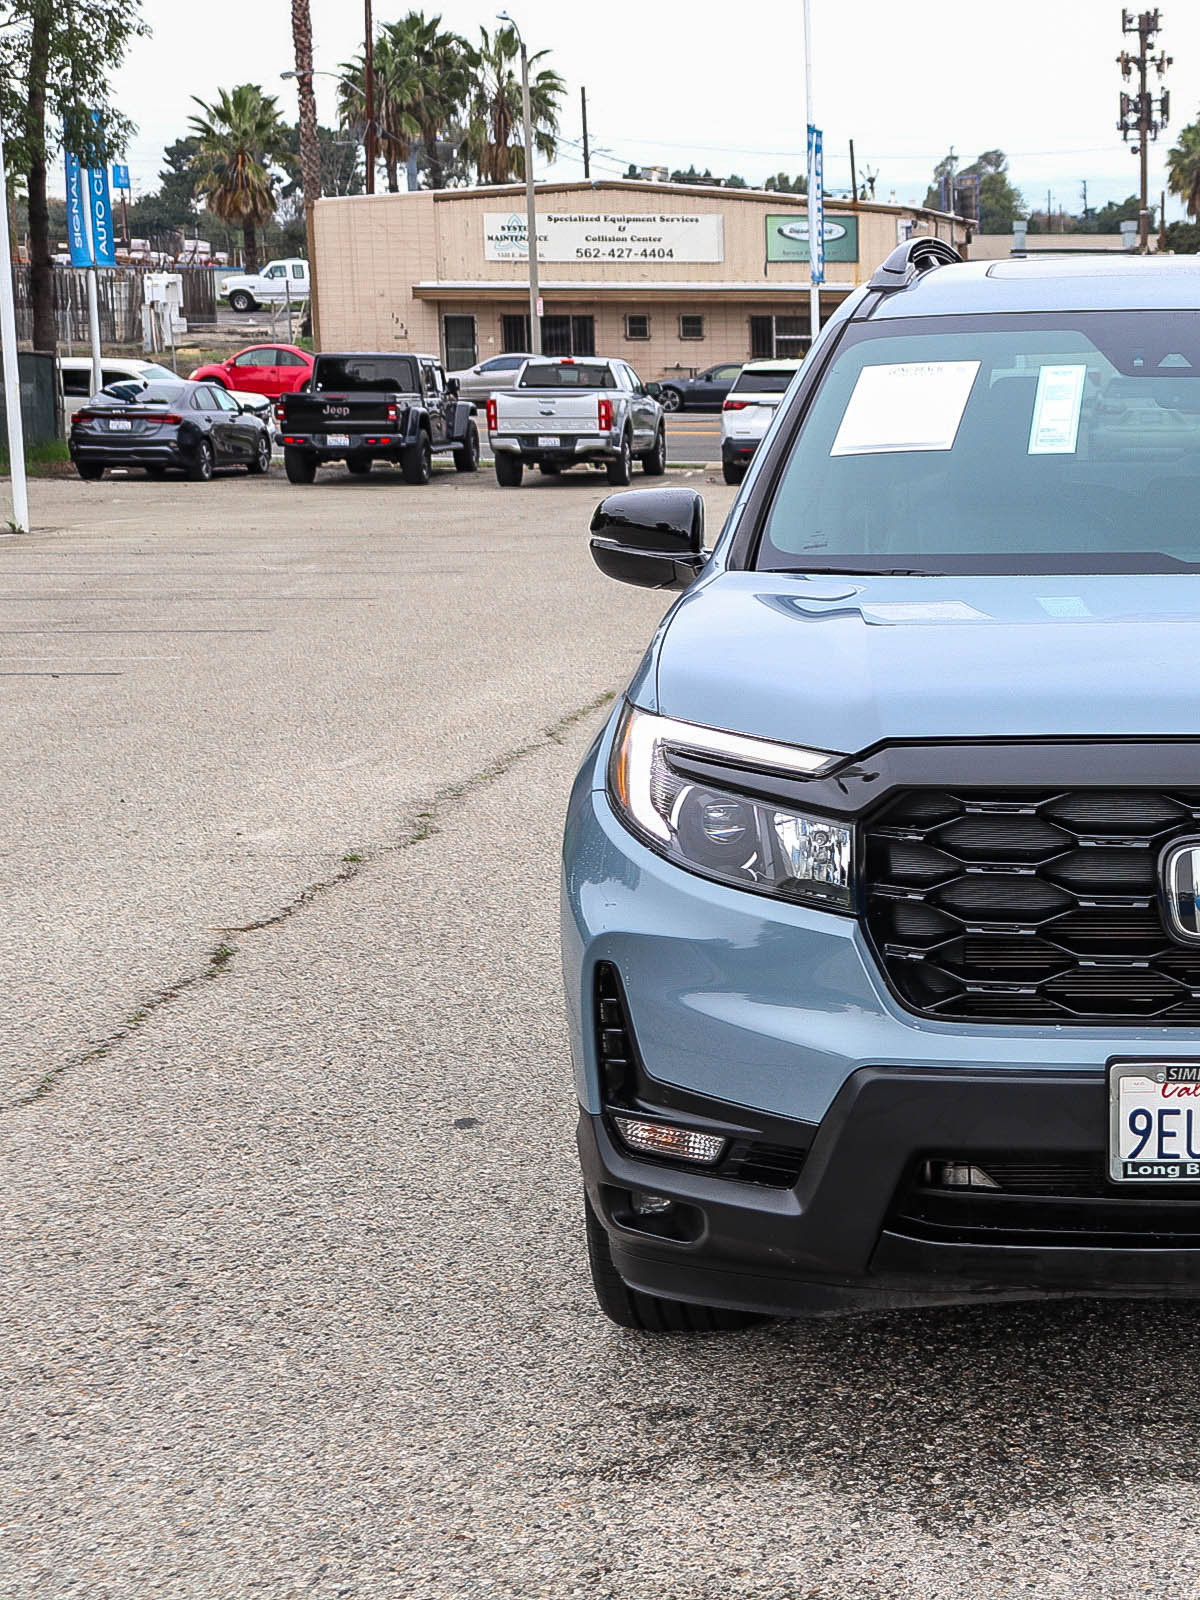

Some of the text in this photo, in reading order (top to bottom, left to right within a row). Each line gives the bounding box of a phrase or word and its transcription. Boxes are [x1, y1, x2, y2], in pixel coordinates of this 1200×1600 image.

[70, 171, 83, 249] SIGNAL
[547, 215, 699, 223] Specialized Equipment Services
[95, 201, 109, 255] AUTO
[576, 247, 674, 259] 562-427-4404
[322, 404, 350, 416] Jeep
[1127, 1163, 1180, 1177] Long
